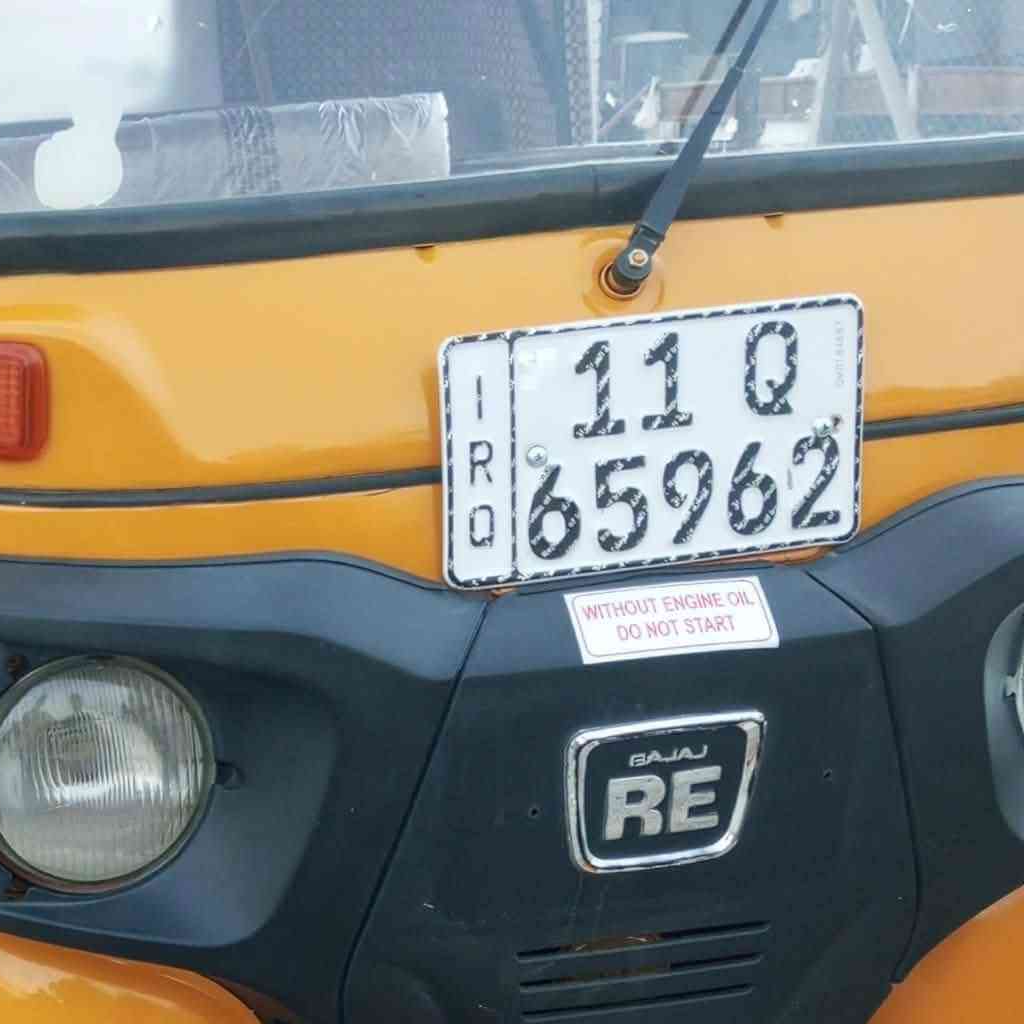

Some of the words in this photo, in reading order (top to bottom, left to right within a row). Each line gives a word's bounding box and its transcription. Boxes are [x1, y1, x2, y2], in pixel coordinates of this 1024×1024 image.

[573, 332, 694, 439] 11
[744, 321, 793, 416] Q
[527, 434, 841, 561] 65962
[582, 598, 658, 621] WITHOUT
[663, 592, 725, 613] ENGINE
[727, 588, 755, 607] OIL
[616, 623, 641, 641] DO
[645, 619, 681, 639] NOT
[685, 614, 736, 635] START
[629, 744, 709, 768] BAJAJ
[603, 765, 722, 841] RE
